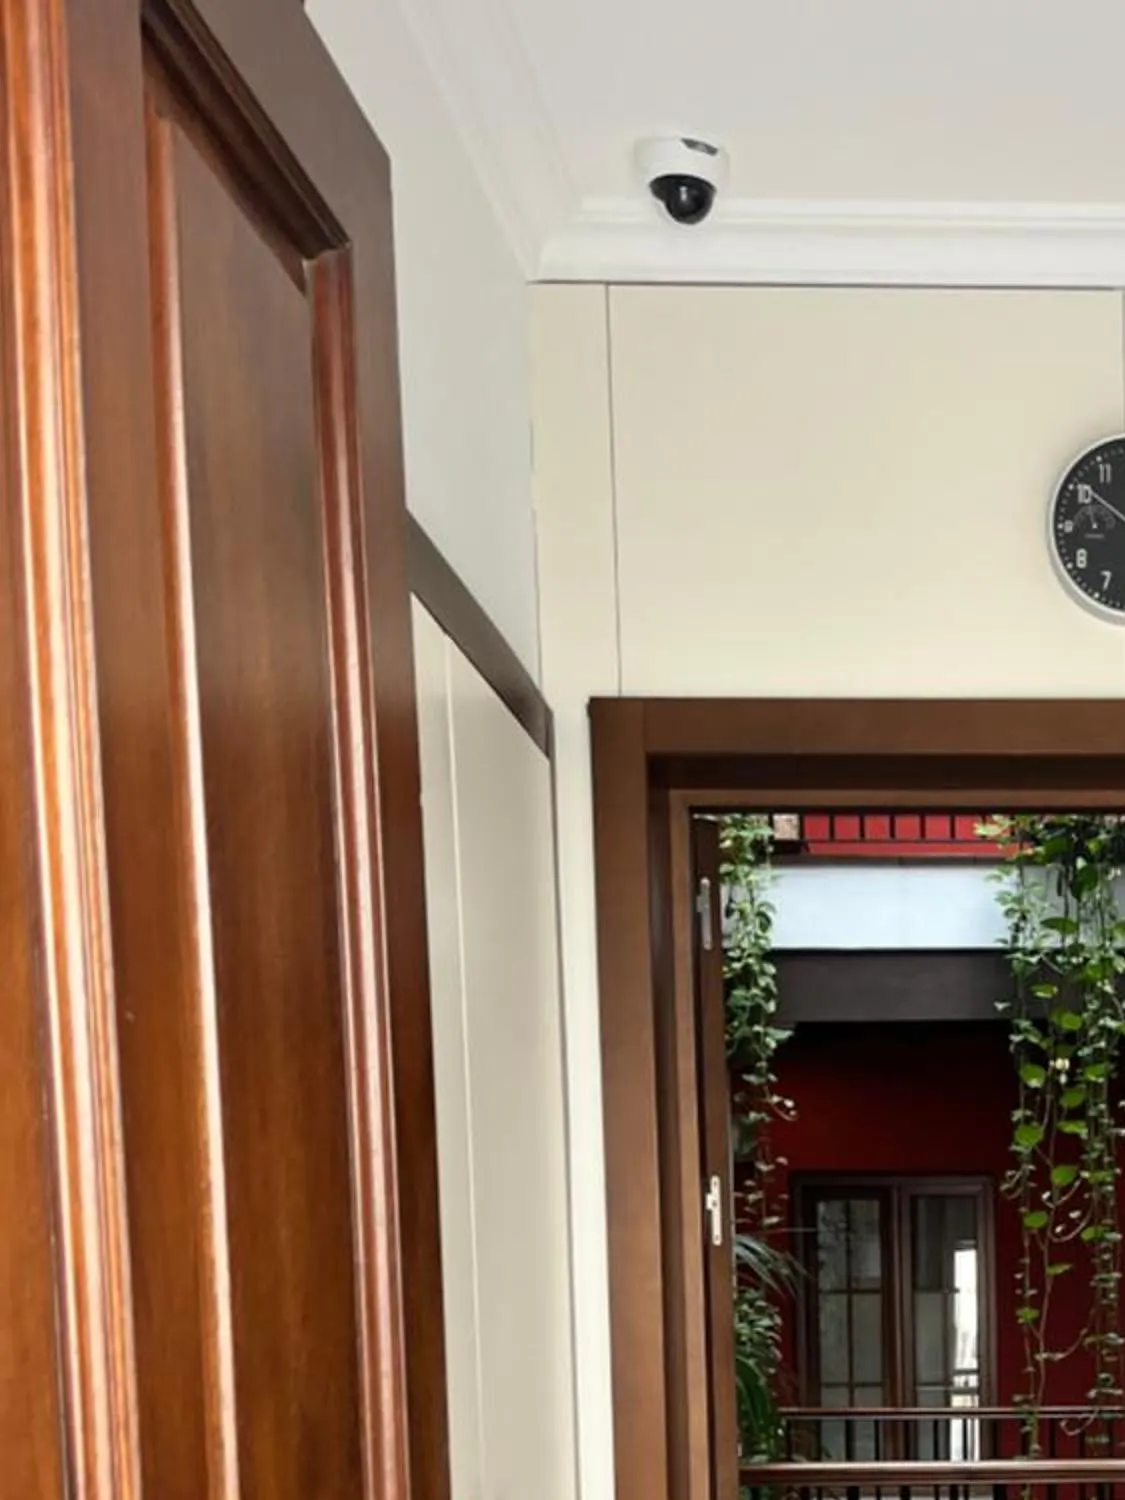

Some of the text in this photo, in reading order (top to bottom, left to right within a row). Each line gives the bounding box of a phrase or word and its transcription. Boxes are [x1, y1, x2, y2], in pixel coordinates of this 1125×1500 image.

[1099, 463, 1112, 484] 11
[1077, 484, 1092, 504] 10
[1076, 548, 1087, 568] 8
[1101, 571, 1112, 590] 7
